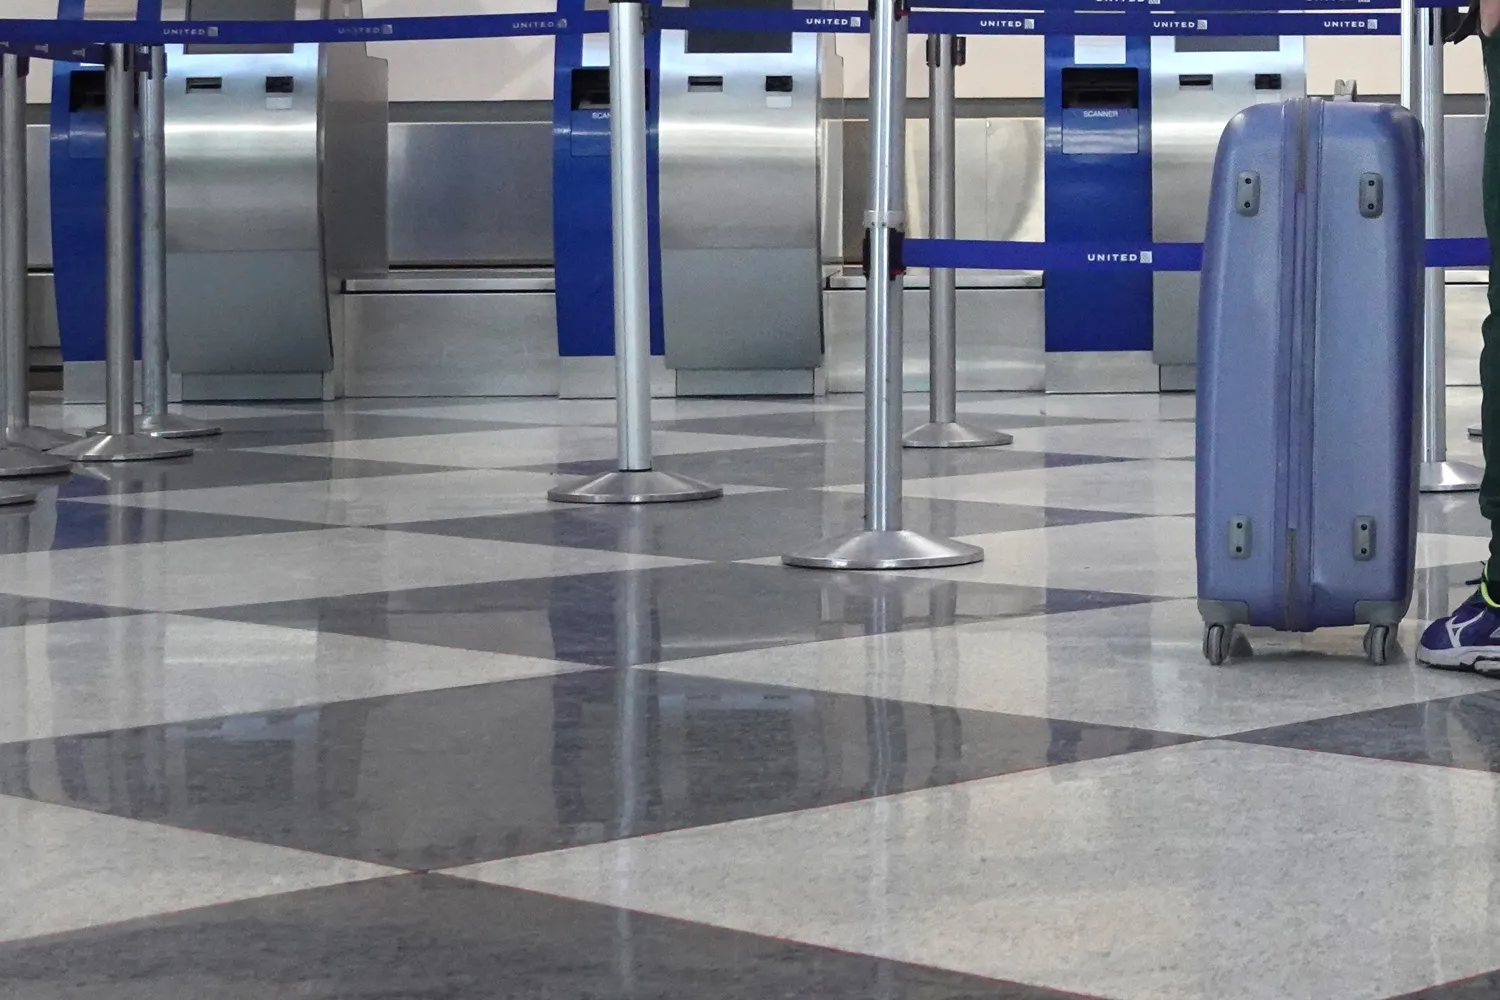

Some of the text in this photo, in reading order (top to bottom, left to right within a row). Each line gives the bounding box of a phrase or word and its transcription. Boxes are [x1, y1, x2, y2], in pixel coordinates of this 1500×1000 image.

[512, 21, 555, 29] UNITED
[806, 18, 848, 26] UNITED
[980, 20, 1022, 28] UNITED
[163, 28, 206, 36] UNITED
[1083, 110, 1119, 118] SCANNER
[1087, 253, 1138, 262] UNITED
